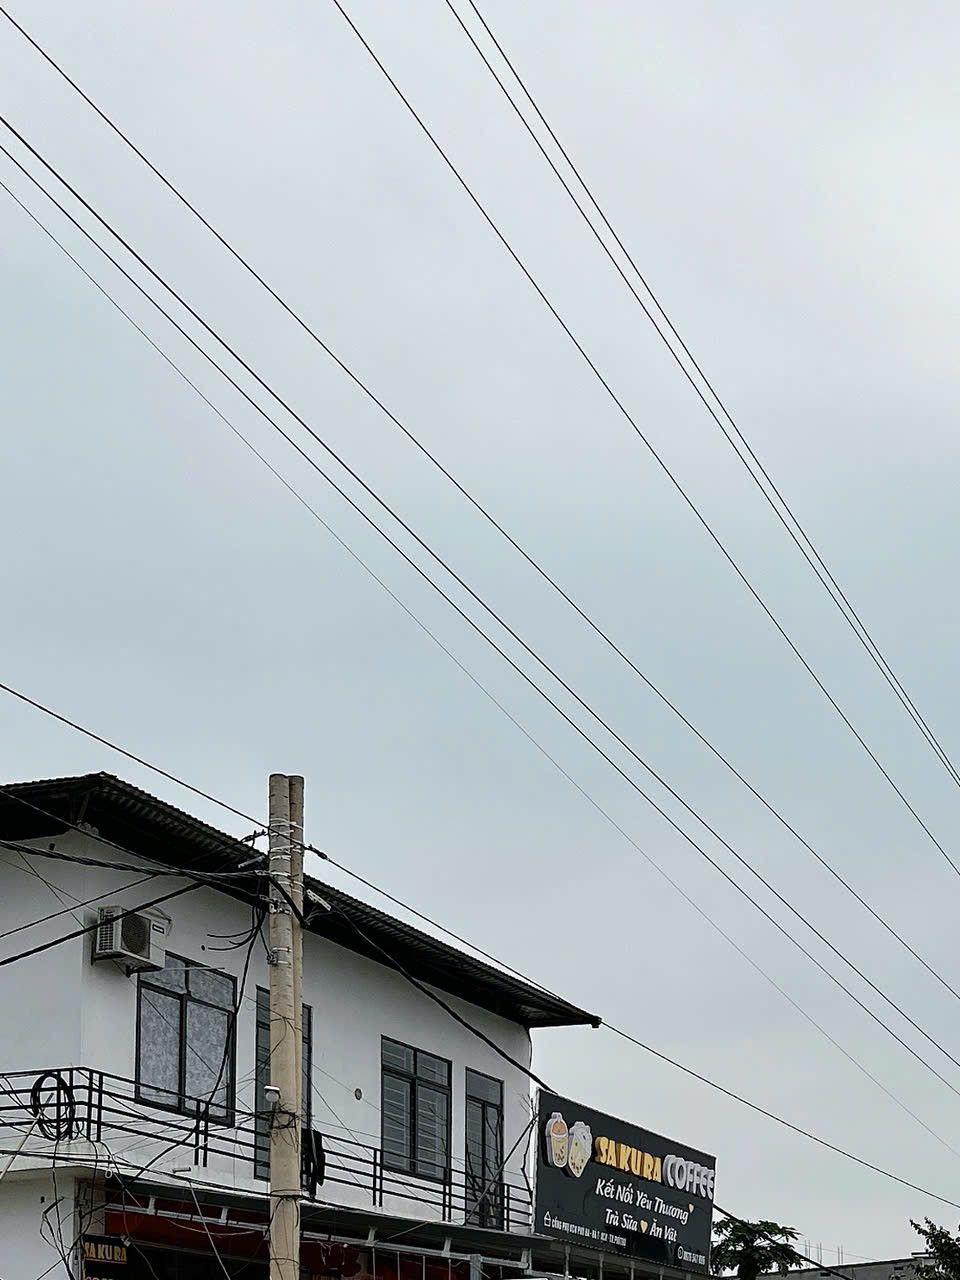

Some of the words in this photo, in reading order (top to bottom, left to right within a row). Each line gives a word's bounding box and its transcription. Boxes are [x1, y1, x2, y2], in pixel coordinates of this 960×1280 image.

[595, 1136, 662, 1184] SAKURA
[662, 1154, 714, 1200] COFFEE
[595, 1178, 615, 1200] Kết
[615, 1182, 634, 1205] Nối
[635, 1190, 653, 1210] Yêu
[653, 1196, 689, 1225] Thương
[605, 1208, 619, 1227] Trà
[620, 1213, 638, 1232] Sữa
[649, 1218, 662, 1239] Ăn
[84, 1241, 128, 1262] SAKURA
